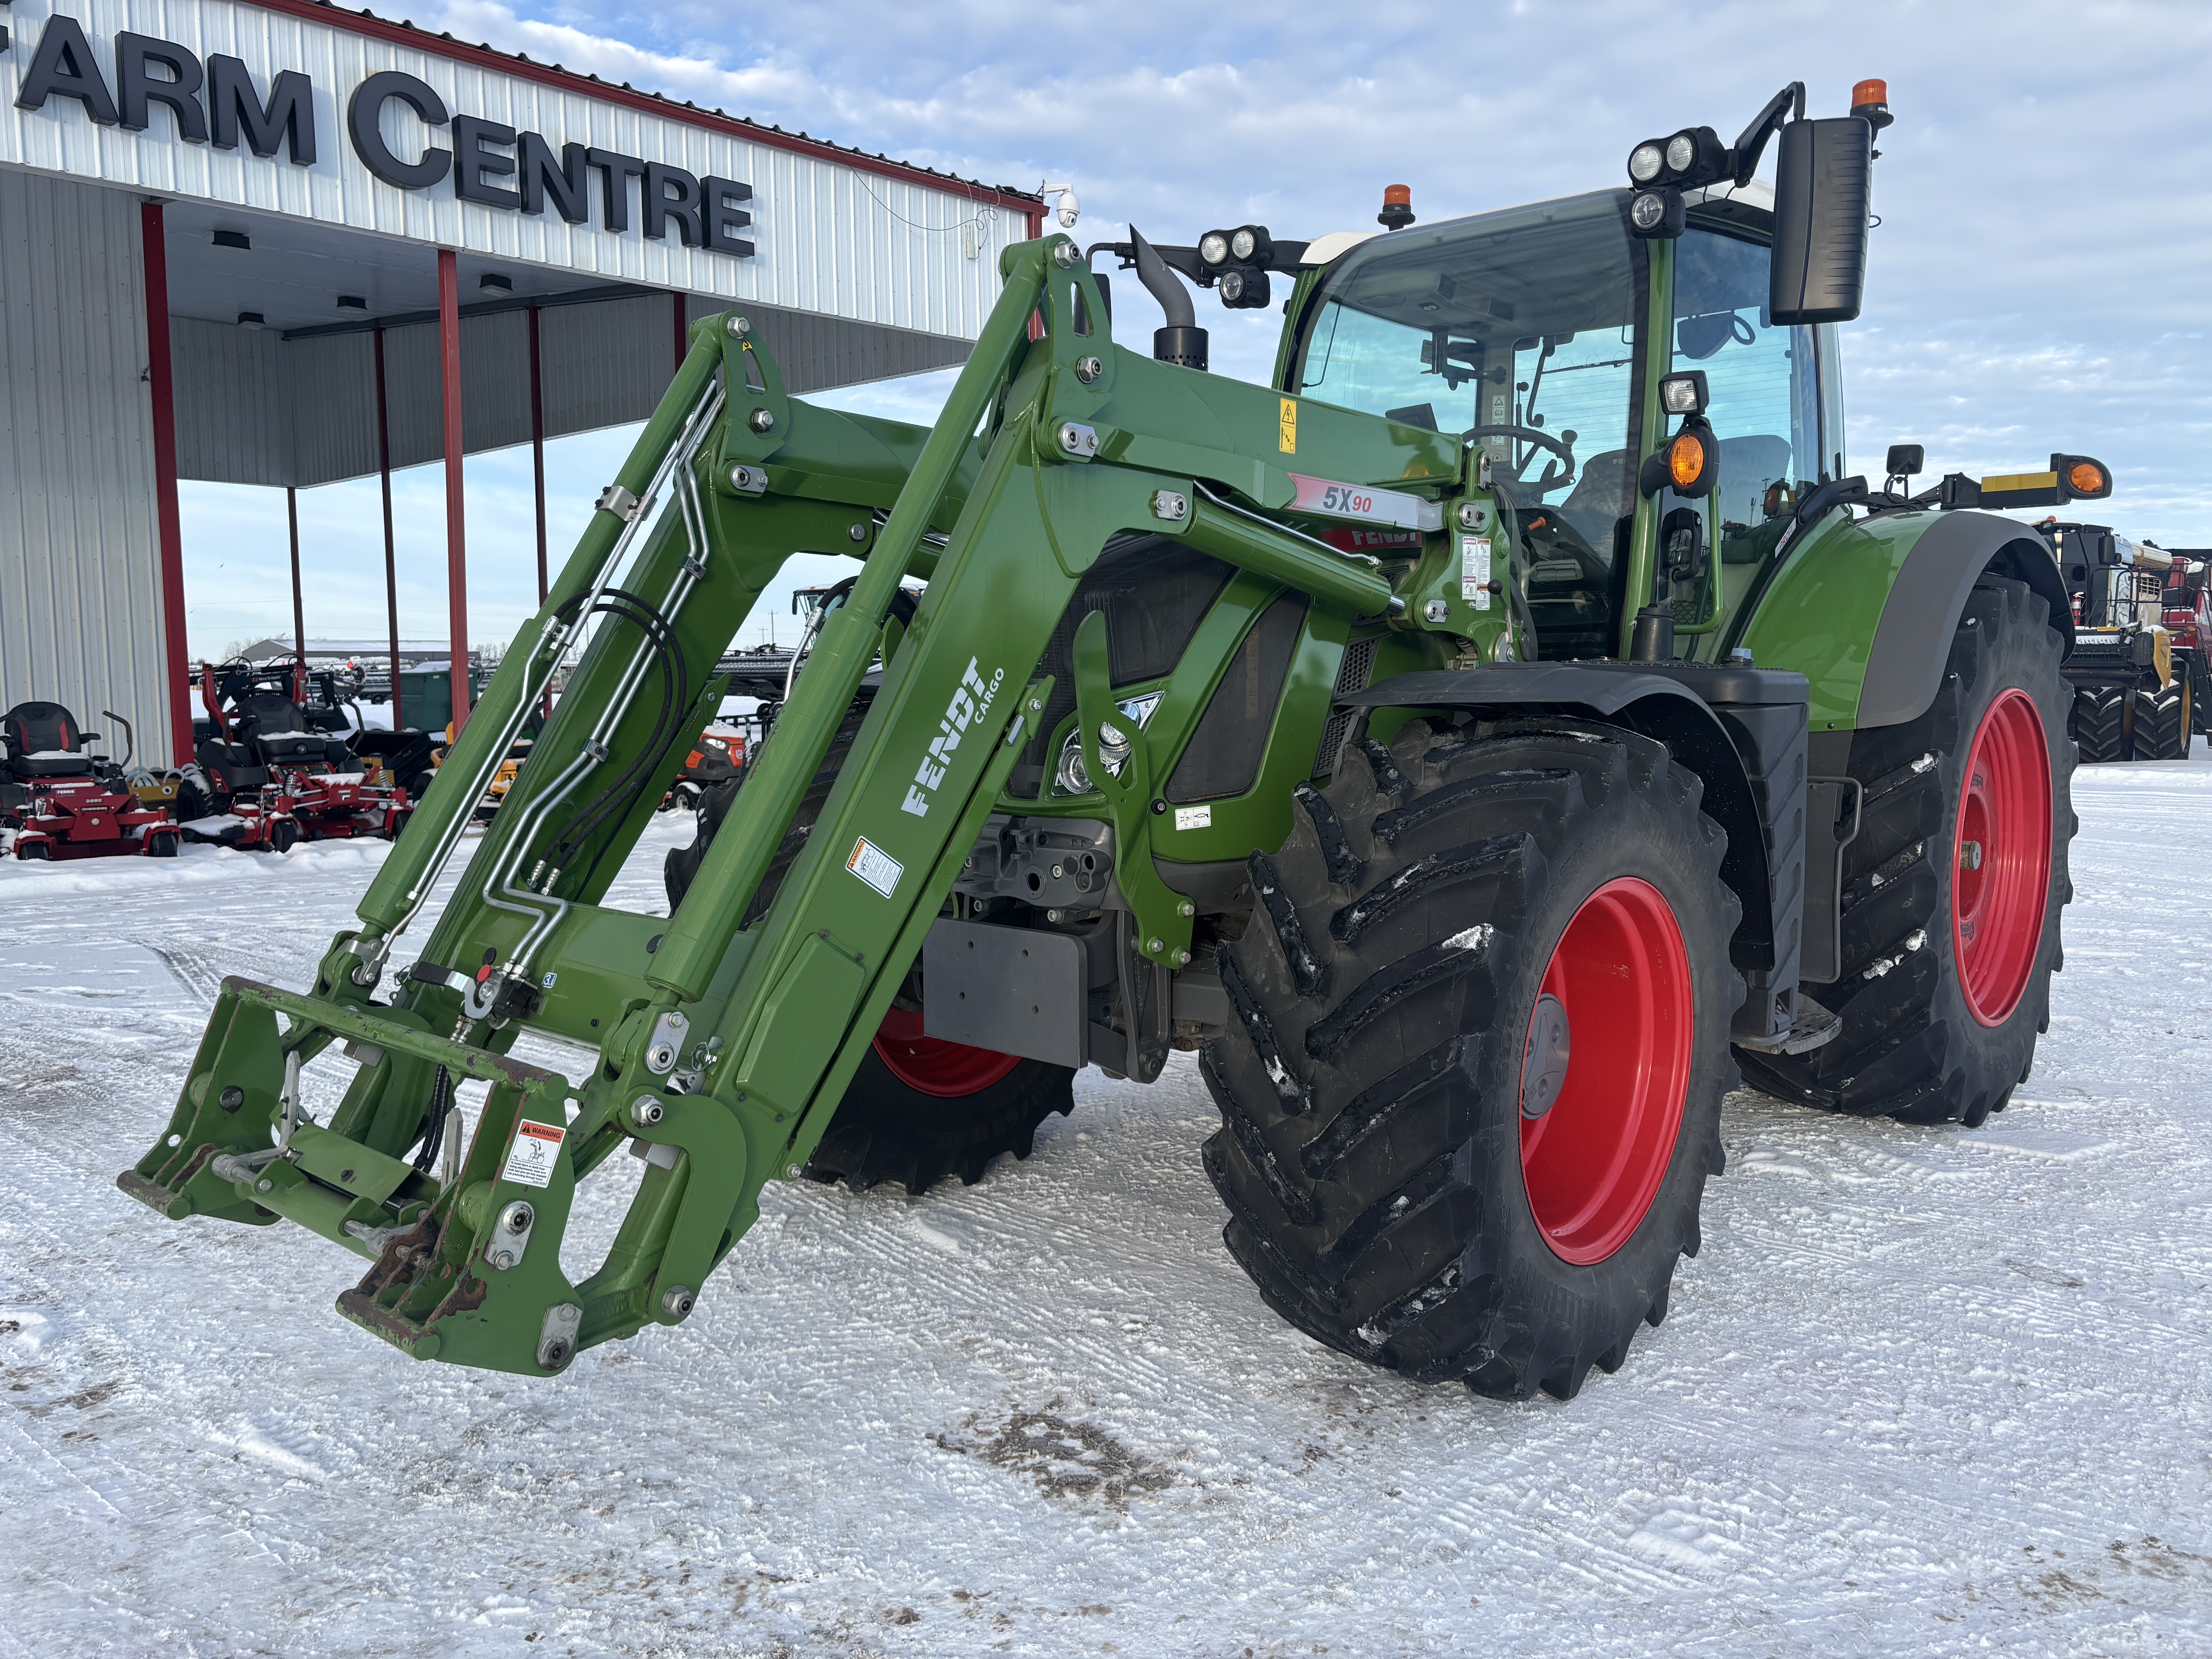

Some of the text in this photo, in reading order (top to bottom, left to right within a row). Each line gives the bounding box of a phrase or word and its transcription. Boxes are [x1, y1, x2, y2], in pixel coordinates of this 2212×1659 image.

[0, 0, 755, 258] ARM CENTRE
[975, 668, 1004, 724] CARGO
[901, 656, 985, 817] FENDT
[852, 841, 865, 864] WARNING
[532, 1127, 561, 1139] WARNING
